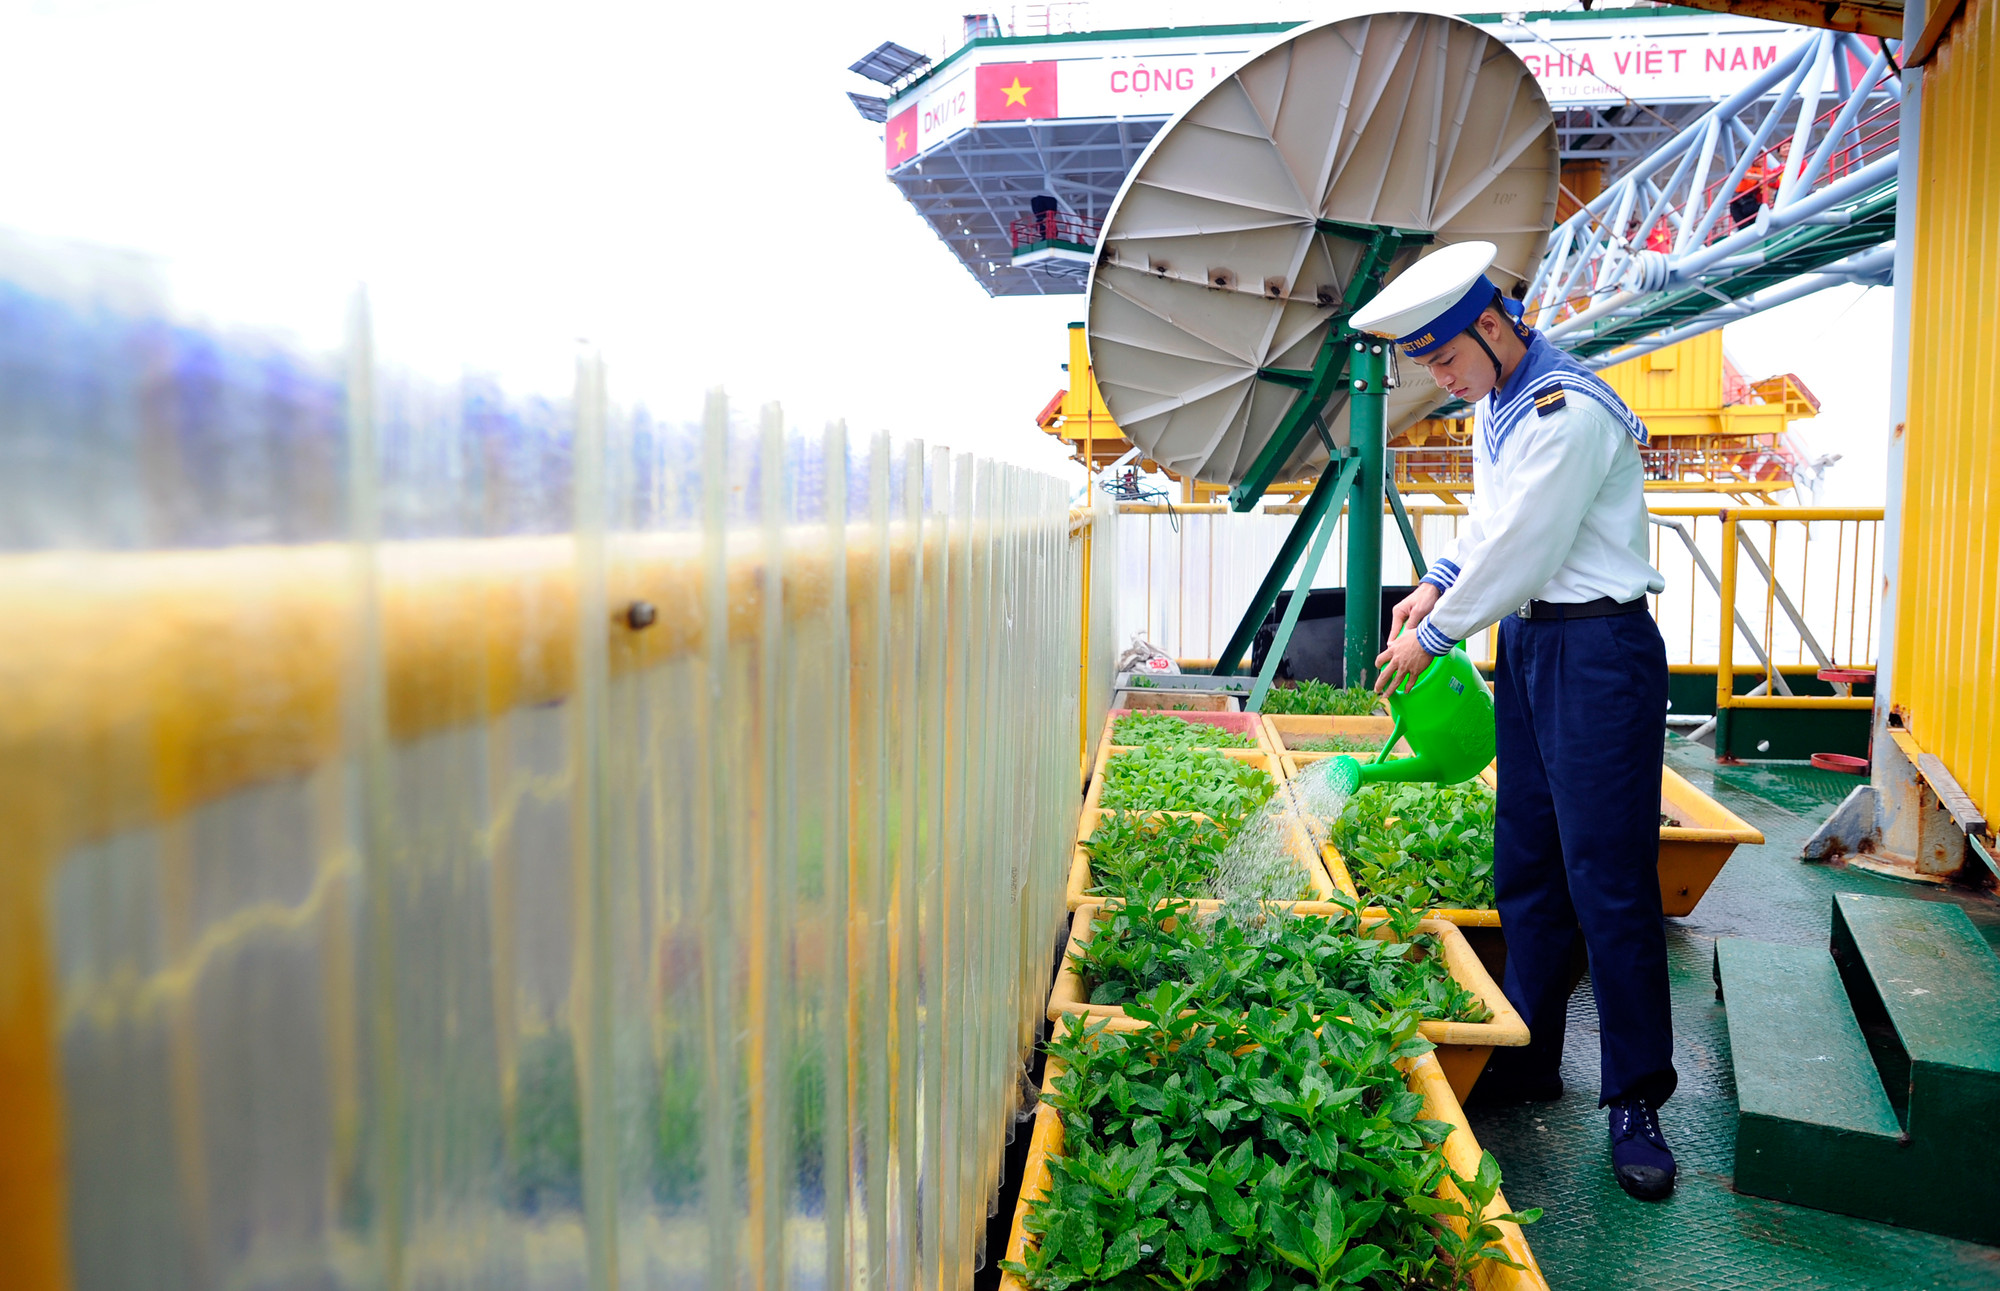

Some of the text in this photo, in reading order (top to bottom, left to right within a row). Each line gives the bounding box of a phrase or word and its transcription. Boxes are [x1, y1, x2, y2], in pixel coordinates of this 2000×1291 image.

[1110, 43, 1777, 98] CỘNG GHĨA VIỆT NAM
[1413, 332, 1436, 349] NAM
